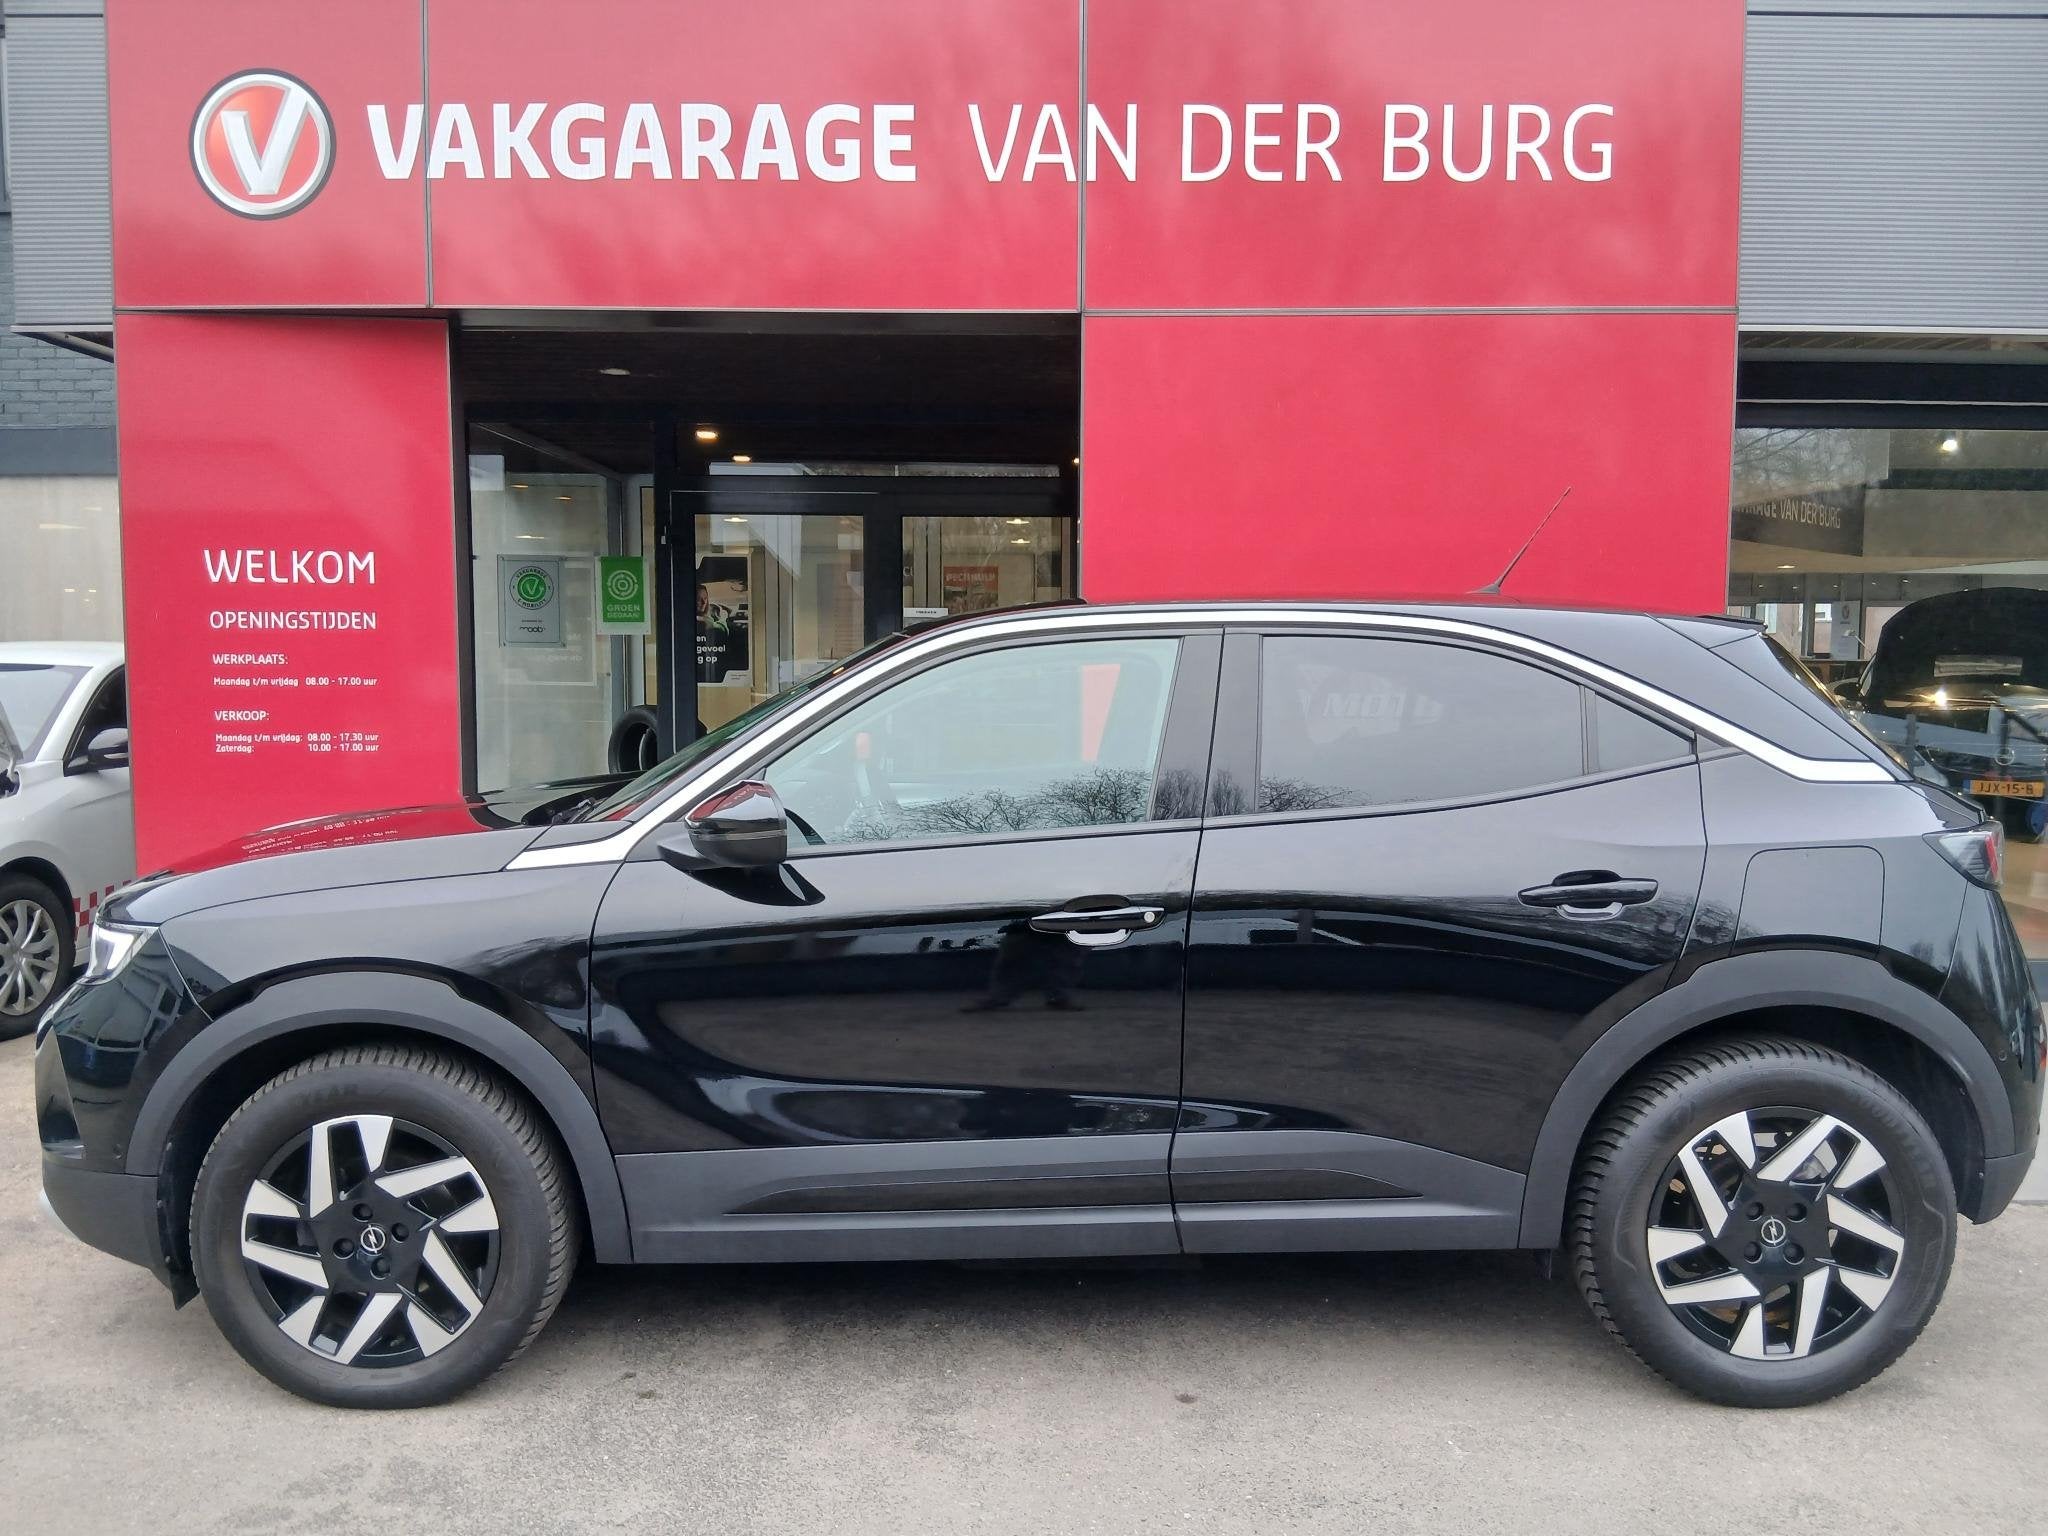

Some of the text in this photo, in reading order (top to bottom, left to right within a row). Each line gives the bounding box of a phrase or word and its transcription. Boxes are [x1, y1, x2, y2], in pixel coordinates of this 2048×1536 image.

[367, 102, 1615, 183] VAKGARAGE VAN DER BURG
[1800, 500, 1818, 525] DER
[1819, 504, 1841, 529] BURG
[203, 549, 376, 584] WELKOM
[606, 604, 641, 612] GROEN
[209, 610, 377, 630] OPENINGSTIJDEN
[212, 653, 288, 665] WERKPLAATS:
[705, 656, 718, 664] op
[213, 677, 251, 687] Maandag
[252, 677, 269, 686] t/m
[270, 677, 299, 687] vrijdag
[305, 677, 330, 686] 08.00
[337, 677, 362, 686] 17.00
[363, 678, 378, 686] uur
[214, 710, 270, 721] VERKOOP:
[215, 733, 253, 743] Maandag
[254, 733, 271, 742] t/m
[307, 733, 332, 742] 08.00
[339, 733, 364, 742] 17.30
[364, 734, 379, 742] uur
[215, 743, 255, 754] Zaterdag:
[308, 743, 332, 752] 10.00
[339, 743, 364, 752] 17.00
[364, 744, 380, 752] uur
